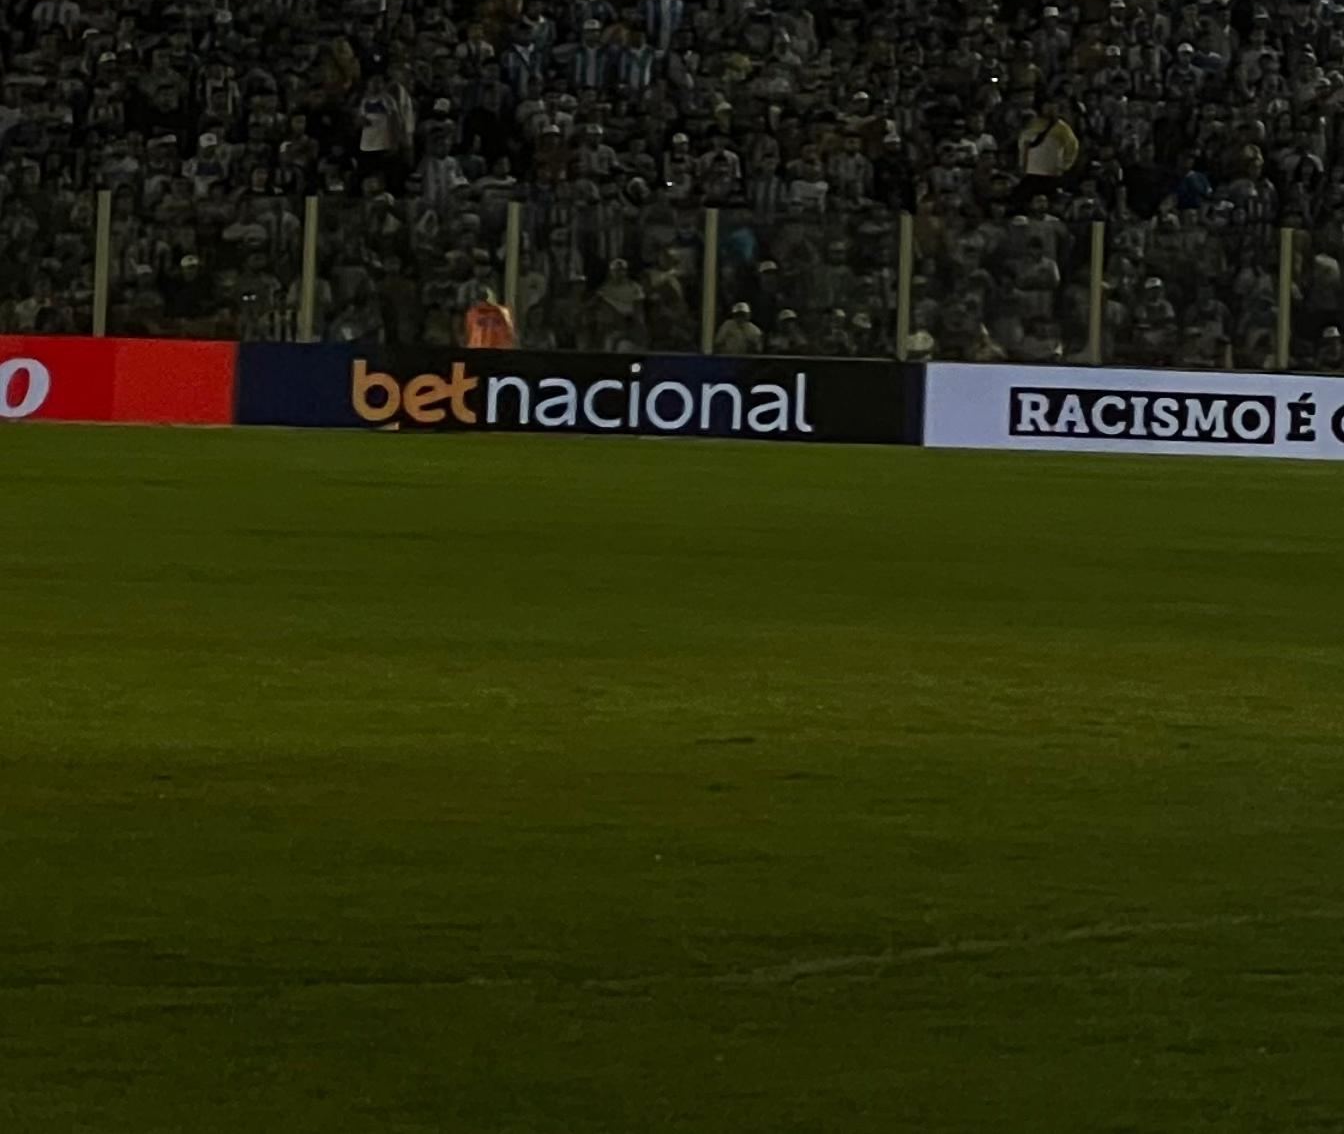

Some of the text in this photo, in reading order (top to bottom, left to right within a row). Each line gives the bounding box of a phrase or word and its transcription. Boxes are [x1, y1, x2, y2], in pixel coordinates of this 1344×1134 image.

[352, 359, 814, 434] betnacional
[1016, 393, 1271, 441] RACISMO
[1285, 392, 1317, 442] É
